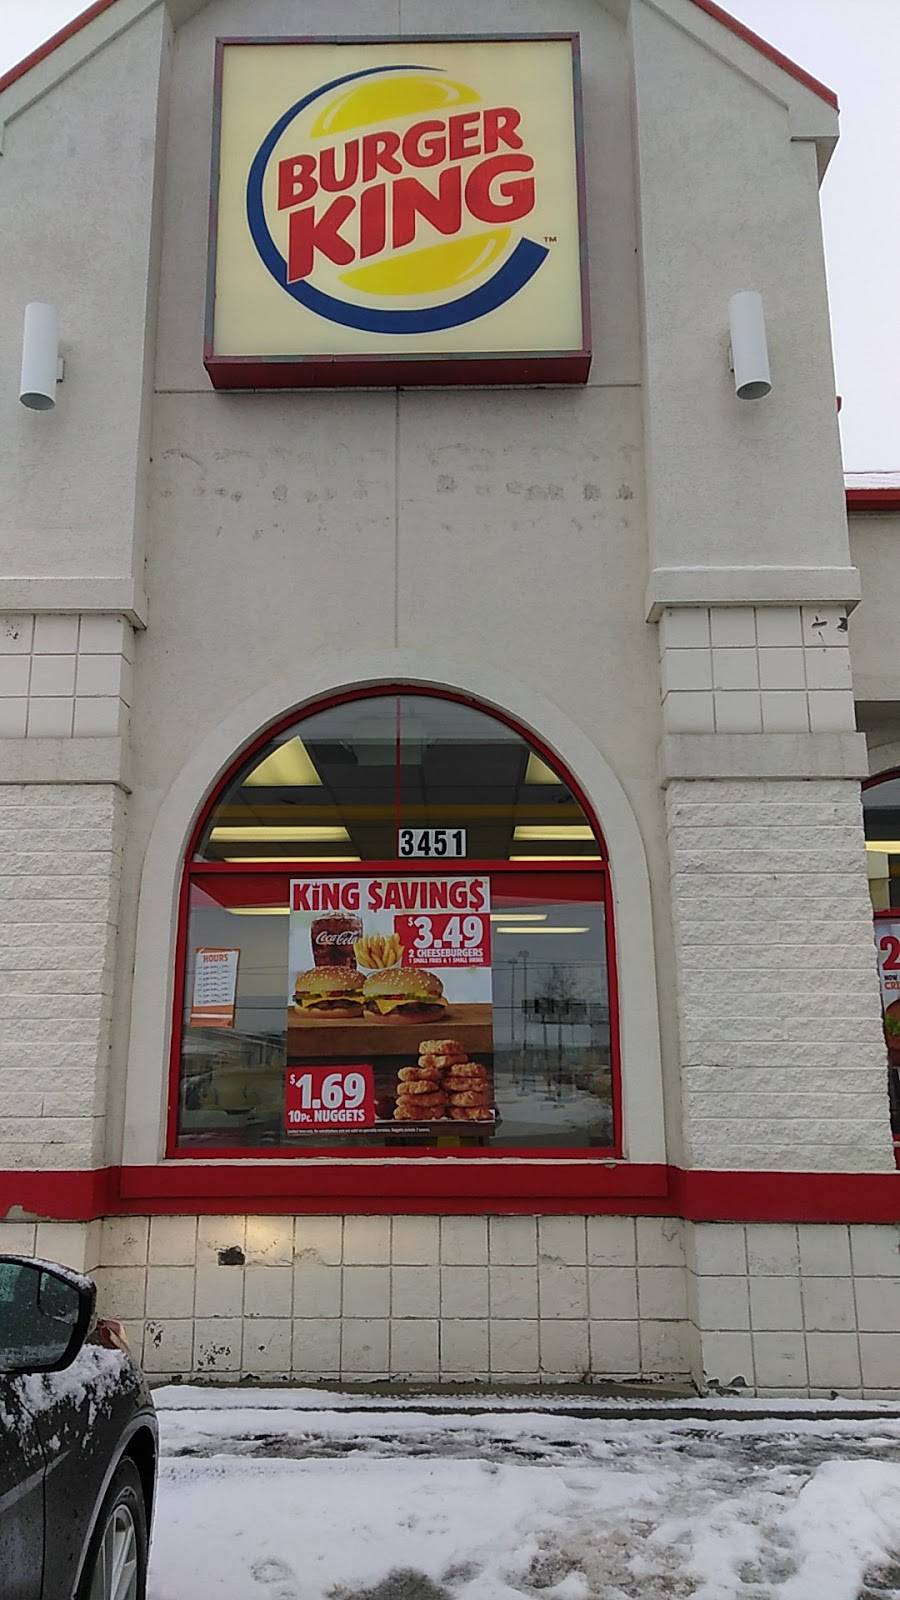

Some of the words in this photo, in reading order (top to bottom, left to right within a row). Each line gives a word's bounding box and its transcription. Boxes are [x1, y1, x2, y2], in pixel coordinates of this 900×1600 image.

[278, 107, 524, 211] BURGER
[288, 153, 535, 282] KING
[401, 831, 463, 856] 3451
[408, 916, 484, 949] $3.49
[203, 953, 229, 962] HOURS
[408, 949, 415, 958] 2
[417, 948, 484, 957] CHEESEBURGERS
[290, 1073, 366, 1109] $1.69
[314, 1109, 365, 1122] NUGGETS
